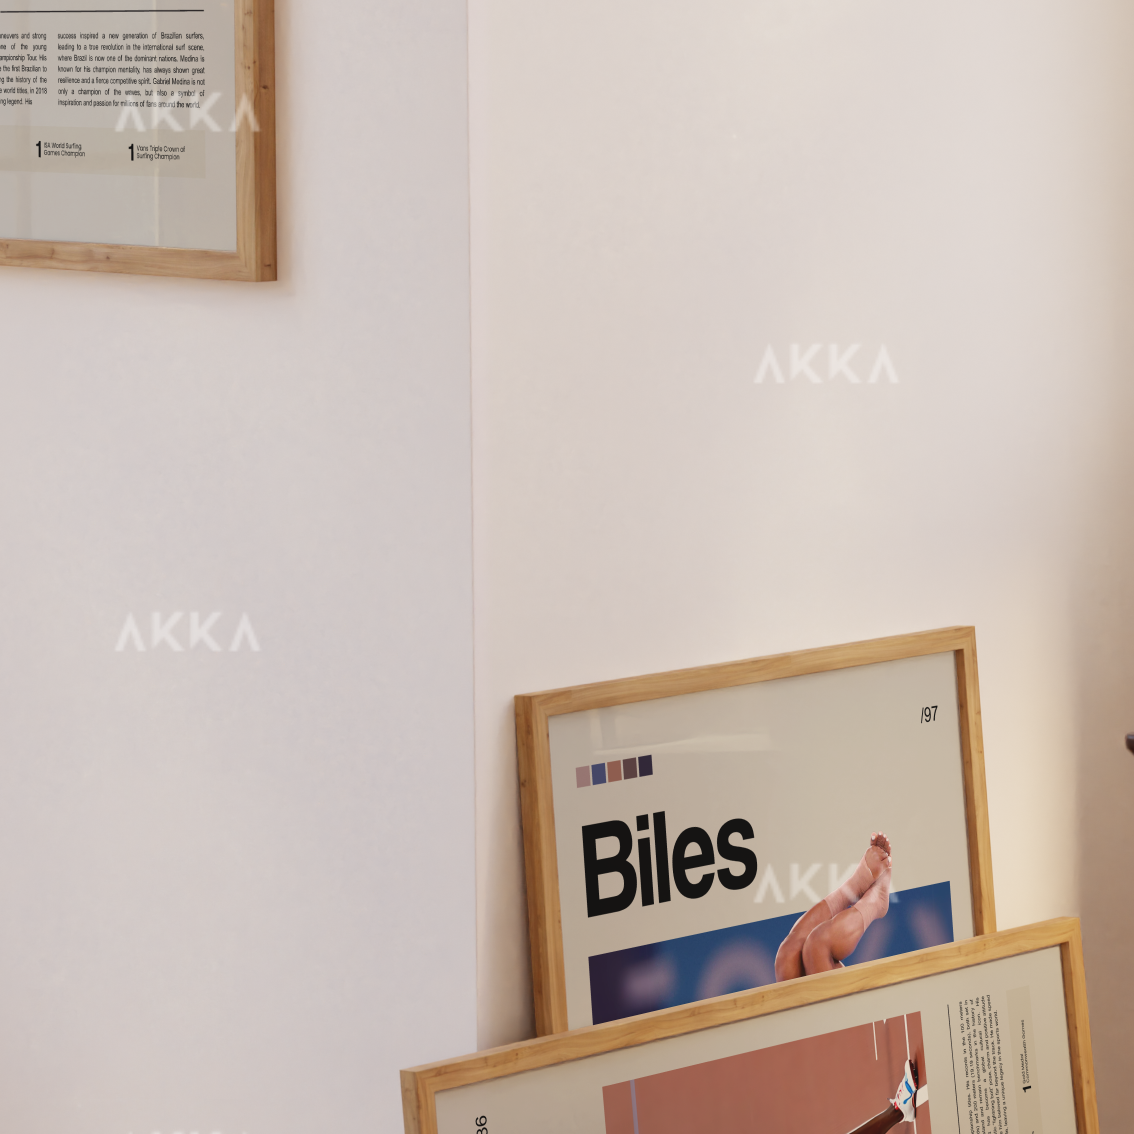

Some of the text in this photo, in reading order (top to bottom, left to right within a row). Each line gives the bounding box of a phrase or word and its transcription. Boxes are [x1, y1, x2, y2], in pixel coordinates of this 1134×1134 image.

[79, 32, 98, 40] inspired
[122, 32, 148, 41] generation
[160, 31, 182, 40] Brazilian
[57, 43, 74, 52] leading
[92, 65, 116, 74] champion
[153, 66, 171, 75] always
[191, 66, 205, 76] great
[36, 140, 42, 158] 1
[65, 142, 81, 151] Surfing
[149, 144, 162, 153] Triple
[60, 150, 85, 158] Champion
[128, 144, 134, 161] 1
[136, 152, 180, 161] Surfing Champion
[920, 705, 938, 724] /97
[582, 810, 758, 918] Biles
